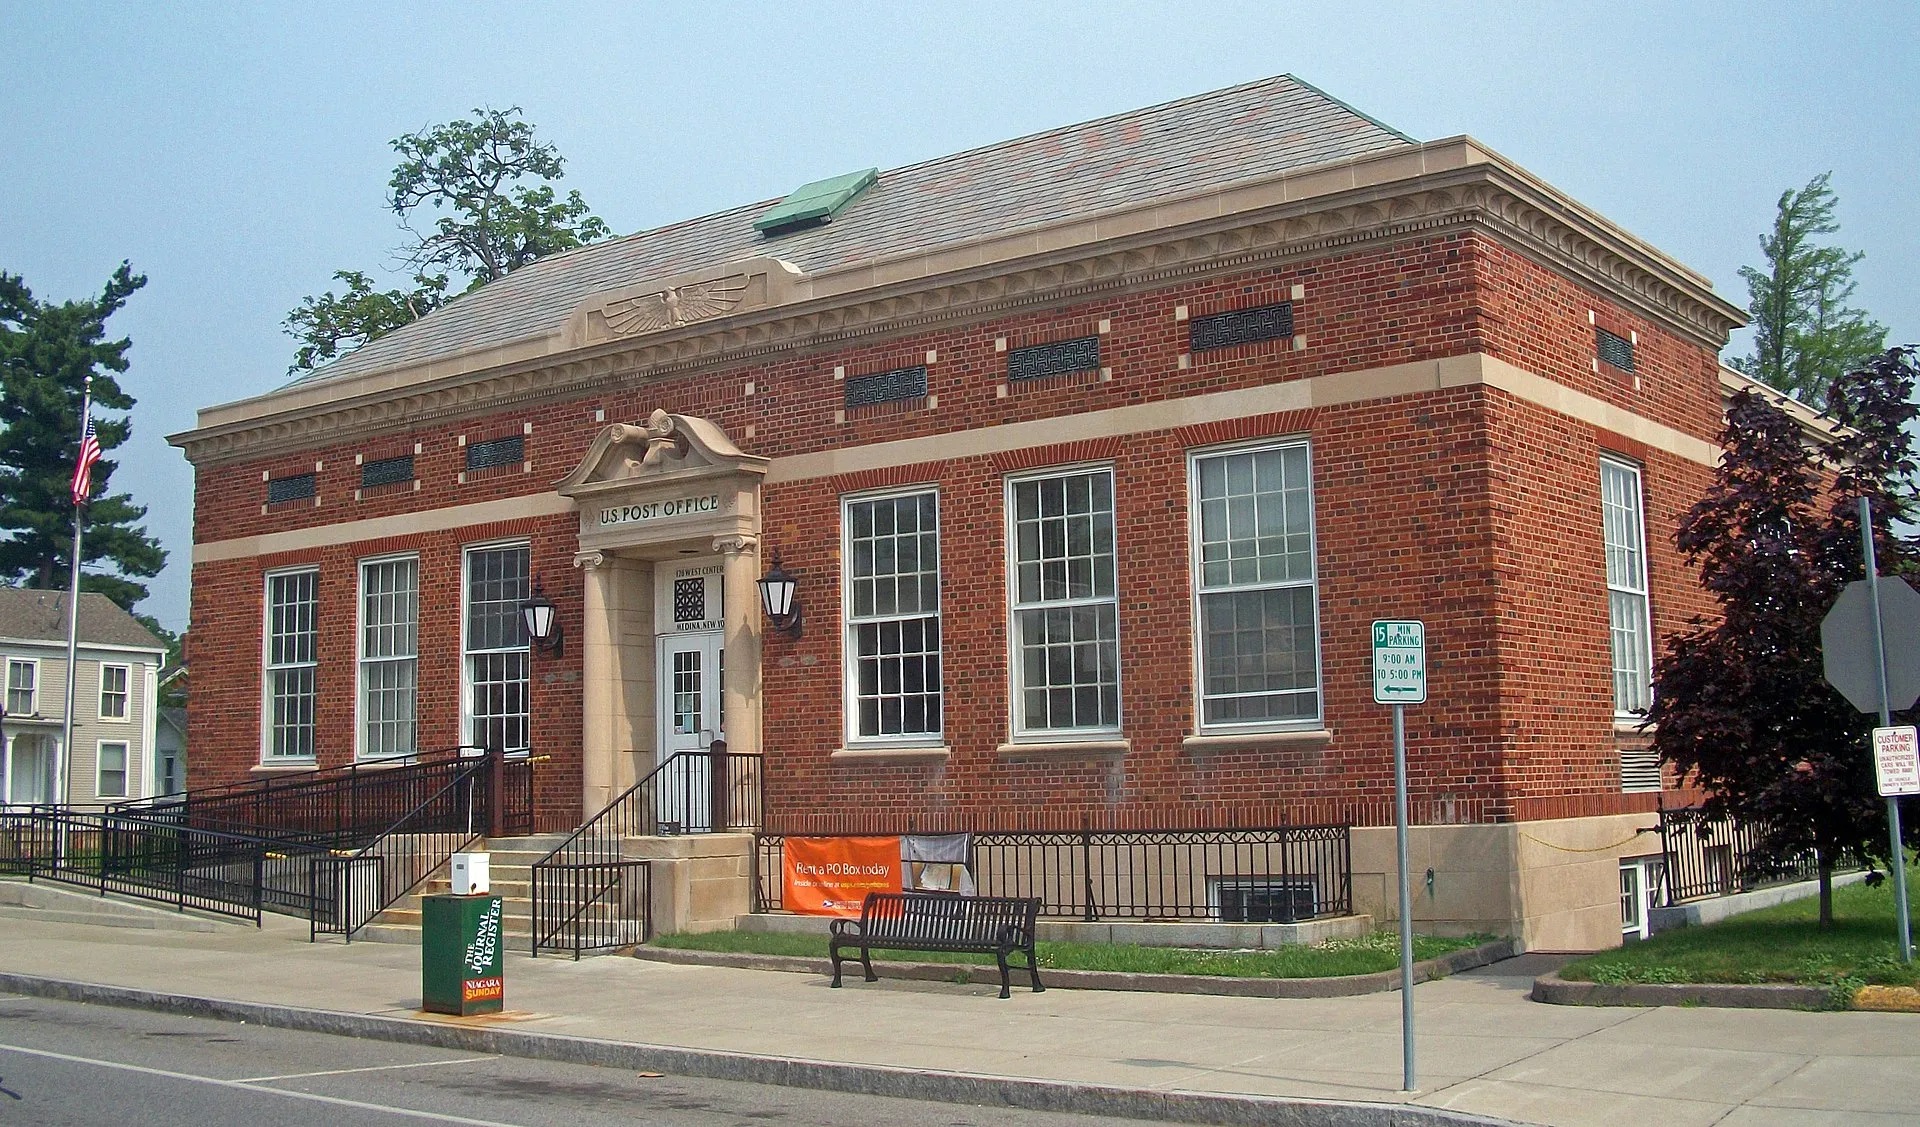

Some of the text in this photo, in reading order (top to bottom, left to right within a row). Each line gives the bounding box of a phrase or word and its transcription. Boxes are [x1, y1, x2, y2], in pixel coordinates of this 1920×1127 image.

[601, 495, 718, 524] U.S. POST OFFICE
[685, 567, 701, 576] WEST
[702, 565, 724, 575] CENTER
[703, 620, 716, 629] NEW
[717, 619, 725, 629] YO
[1375, 627, 1386, 642] 15
[1397, 625, 1411, 634] MIN
[1389, 635, 1420, 645] PARKING
[1382, 654, 1415, 664] 9:00 AM
[1390, 669, 1408, 679] 5:00
[1412, 669, 1421, 679] PM
[1878, 734, 1913, 743] CUSTOMER
[1882, 744, 1910, 752] PARKING
[796, 862, 890, 878] Rent a PO Box today
[481, 899, 502, 967] REGISTER
[471, 911, 490, 975] JOURNAL
[465, 943, 475, 965] THE
[466, 979, 501, 989] NIAGARA
[466, 986, 501, 1000] SUNDAY
